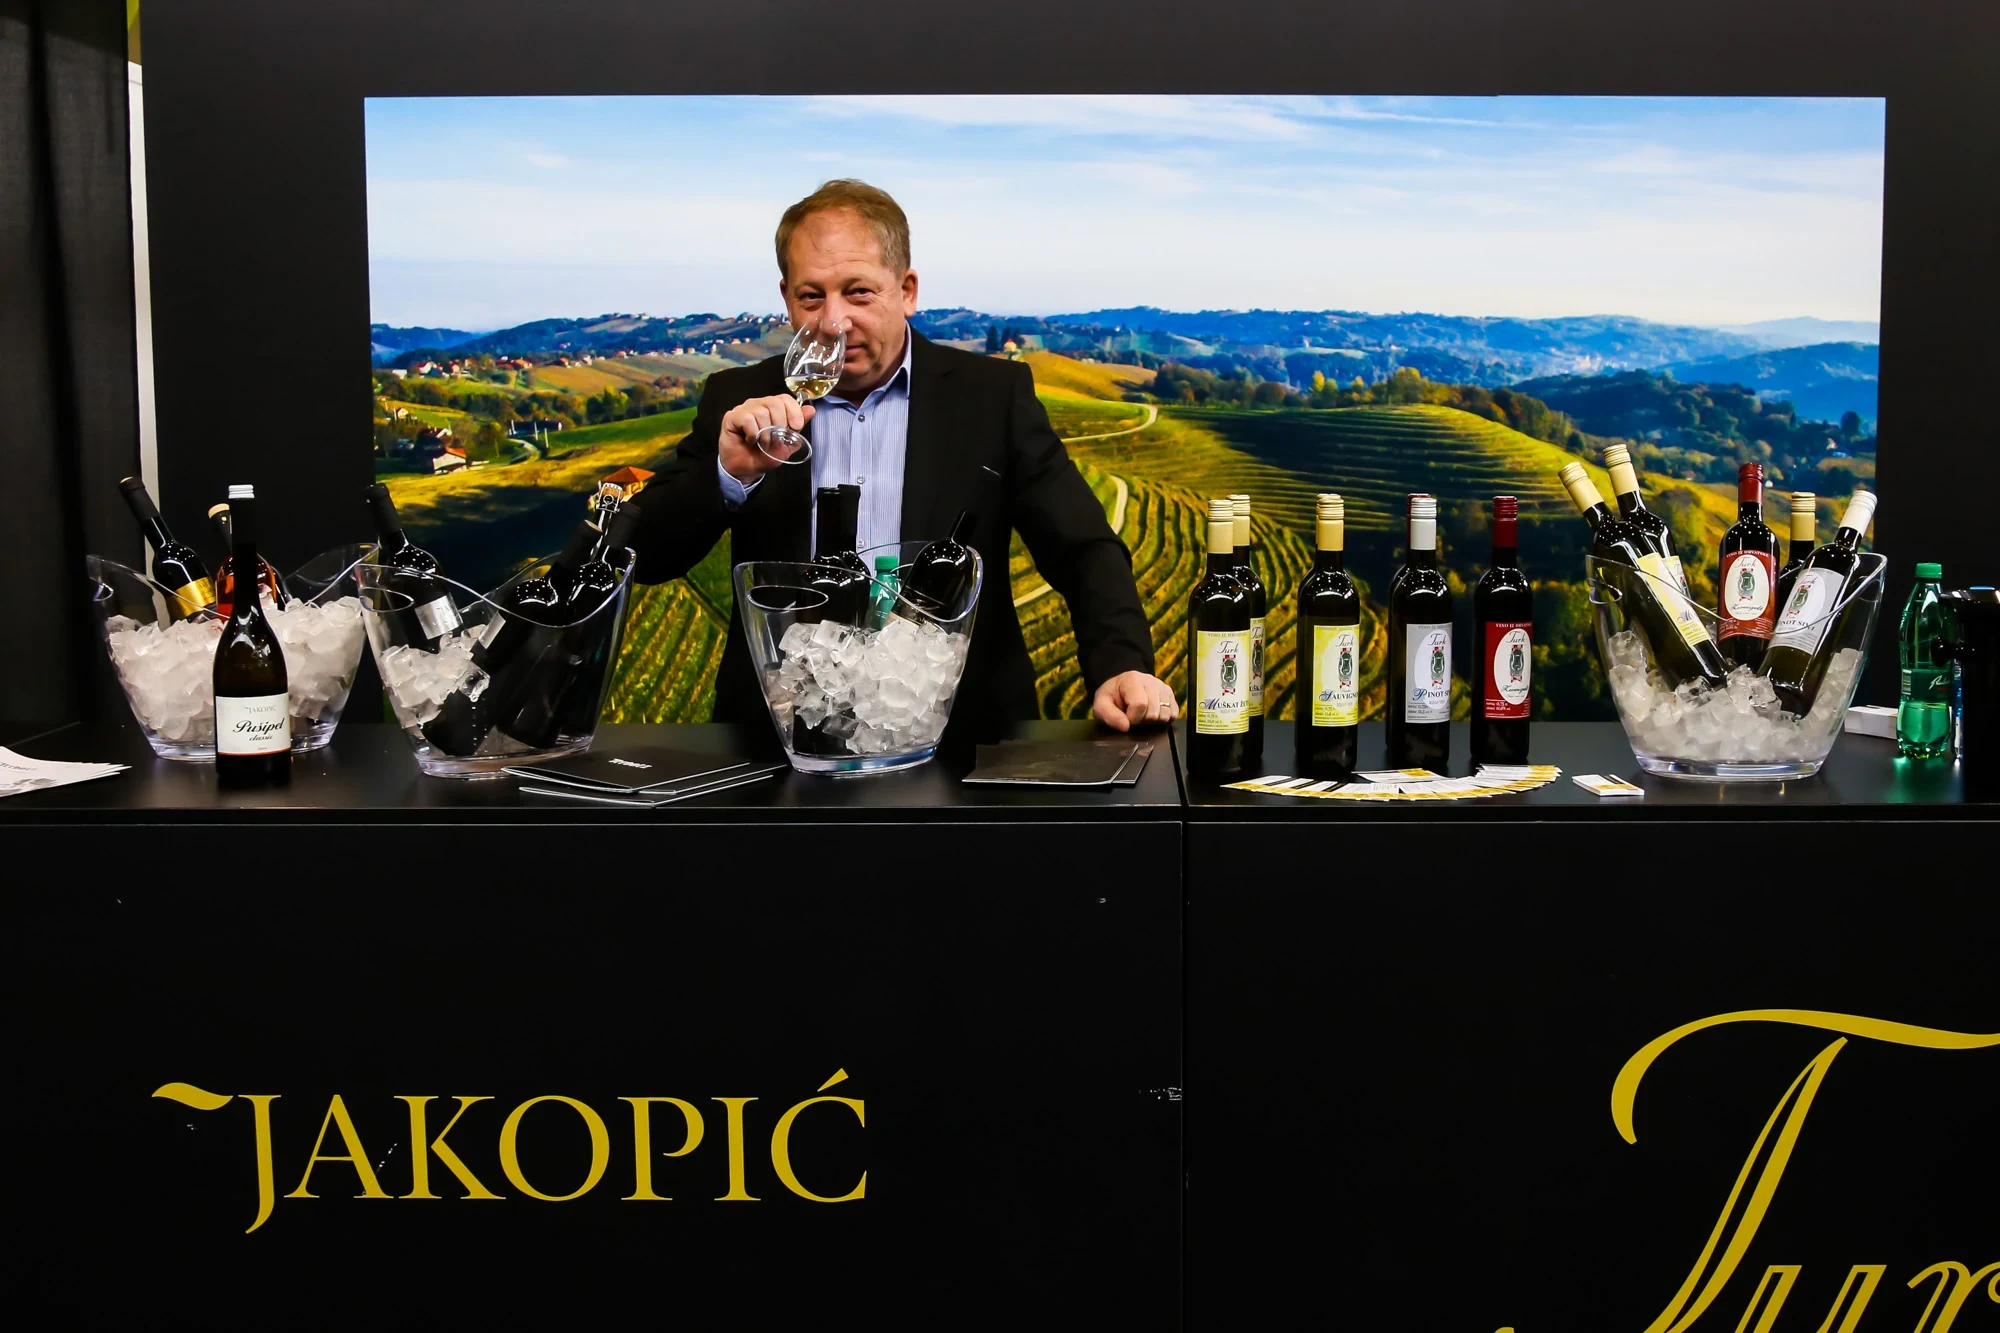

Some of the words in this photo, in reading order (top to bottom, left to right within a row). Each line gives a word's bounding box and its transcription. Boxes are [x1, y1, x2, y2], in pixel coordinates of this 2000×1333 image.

[1734, 557, 1757, 568] Turk
[1335, 634, 1354, 647] Turk
[1427, 633, 1446, 646] Turk
[1506, 631, 1526, 644] Turk
[1217, 641, 1239, 653] Turk
[1412, 688, 1443, 700] PINOT
[1199, 698, 1239, 710] MUŠKAT
[232, 717, 285, 735] Pušipel
[248, 734, 273, 742] classic
[151, 1068, 867, 1234] JAKOPIĆ
